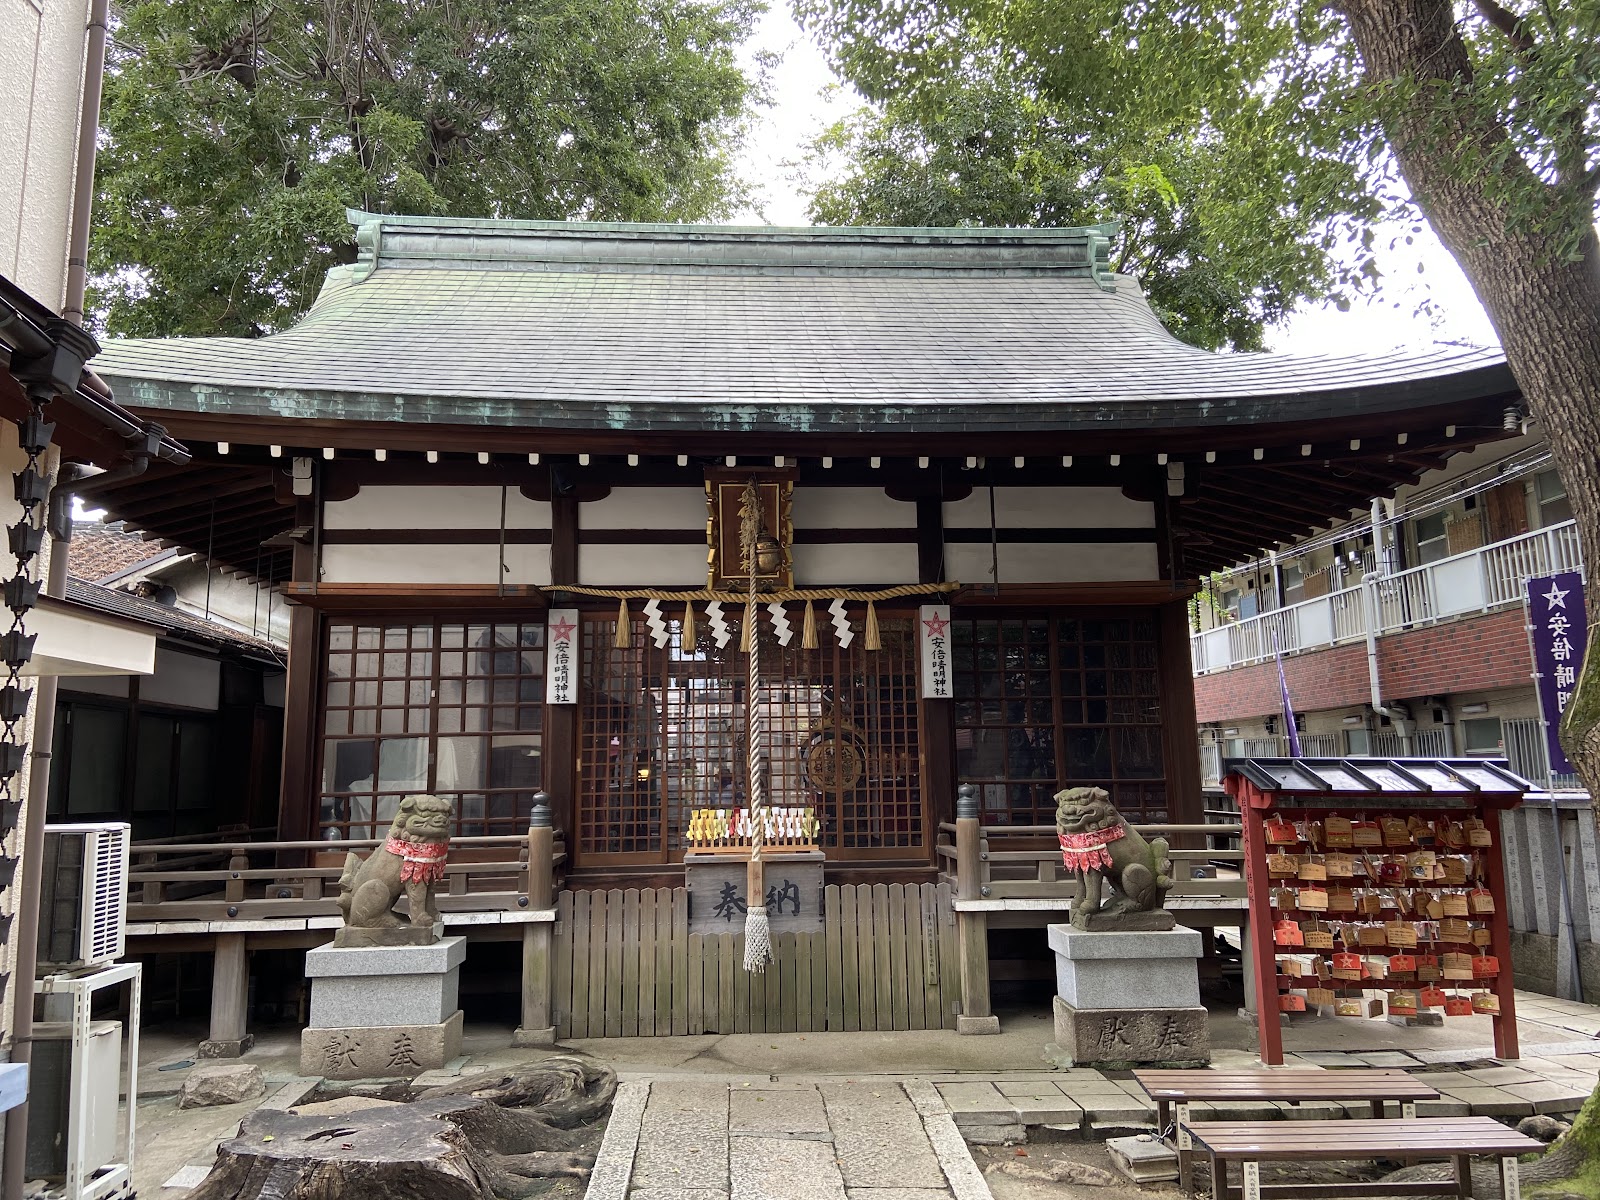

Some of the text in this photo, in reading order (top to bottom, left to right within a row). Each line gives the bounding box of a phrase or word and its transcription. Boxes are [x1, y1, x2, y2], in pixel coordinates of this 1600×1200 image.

[554, 641, 570, 702] 安倍晴明神社
[931, 637, 947, 696] 安倍晴明神社
[712, 879, 801, 923] 奉納
